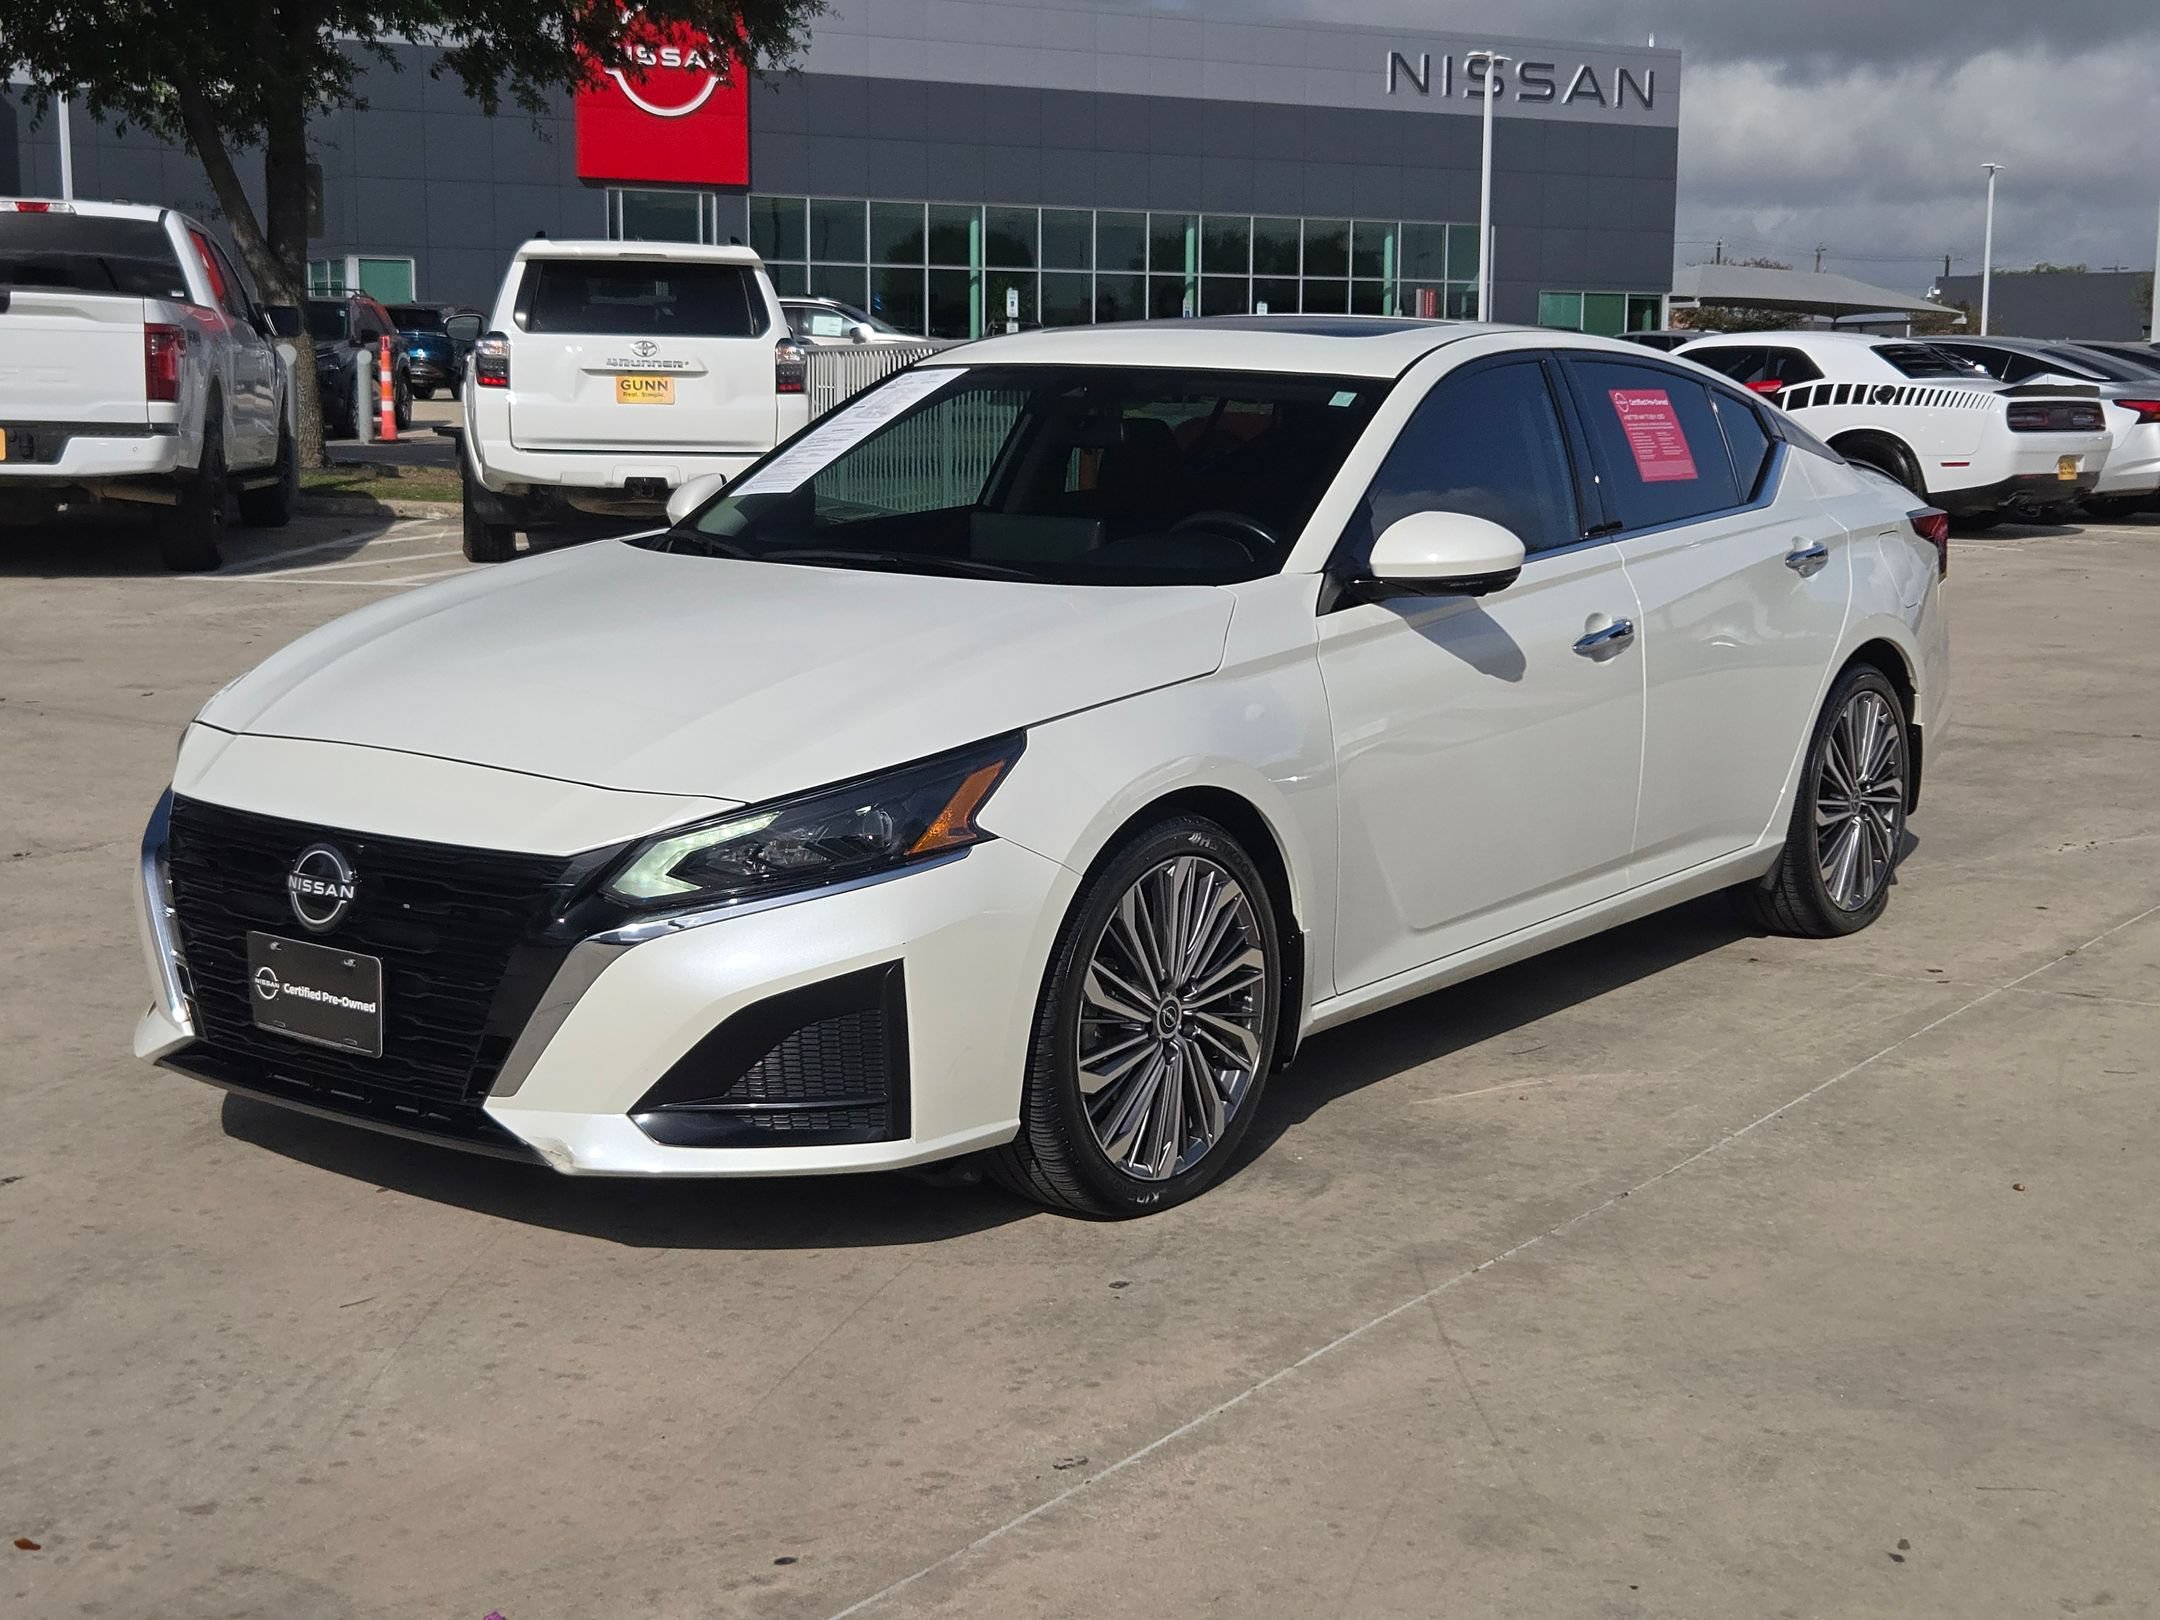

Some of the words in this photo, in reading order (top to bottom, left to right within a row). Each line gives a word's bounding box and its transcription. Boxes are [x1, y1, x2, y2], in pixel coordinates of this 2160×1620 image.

[606, 43, 729, 71] ISSA
[1386, 50, 1655, 111] NISSAN
[620, 379, 668, 391] GUNN
[288, 875, 354, 899] NISSAN
[255, 977, 280, 989] NISSAN
[283, 982, 321, 1001] Certified
[322, 992, 376, 1013] Pre-Owned
